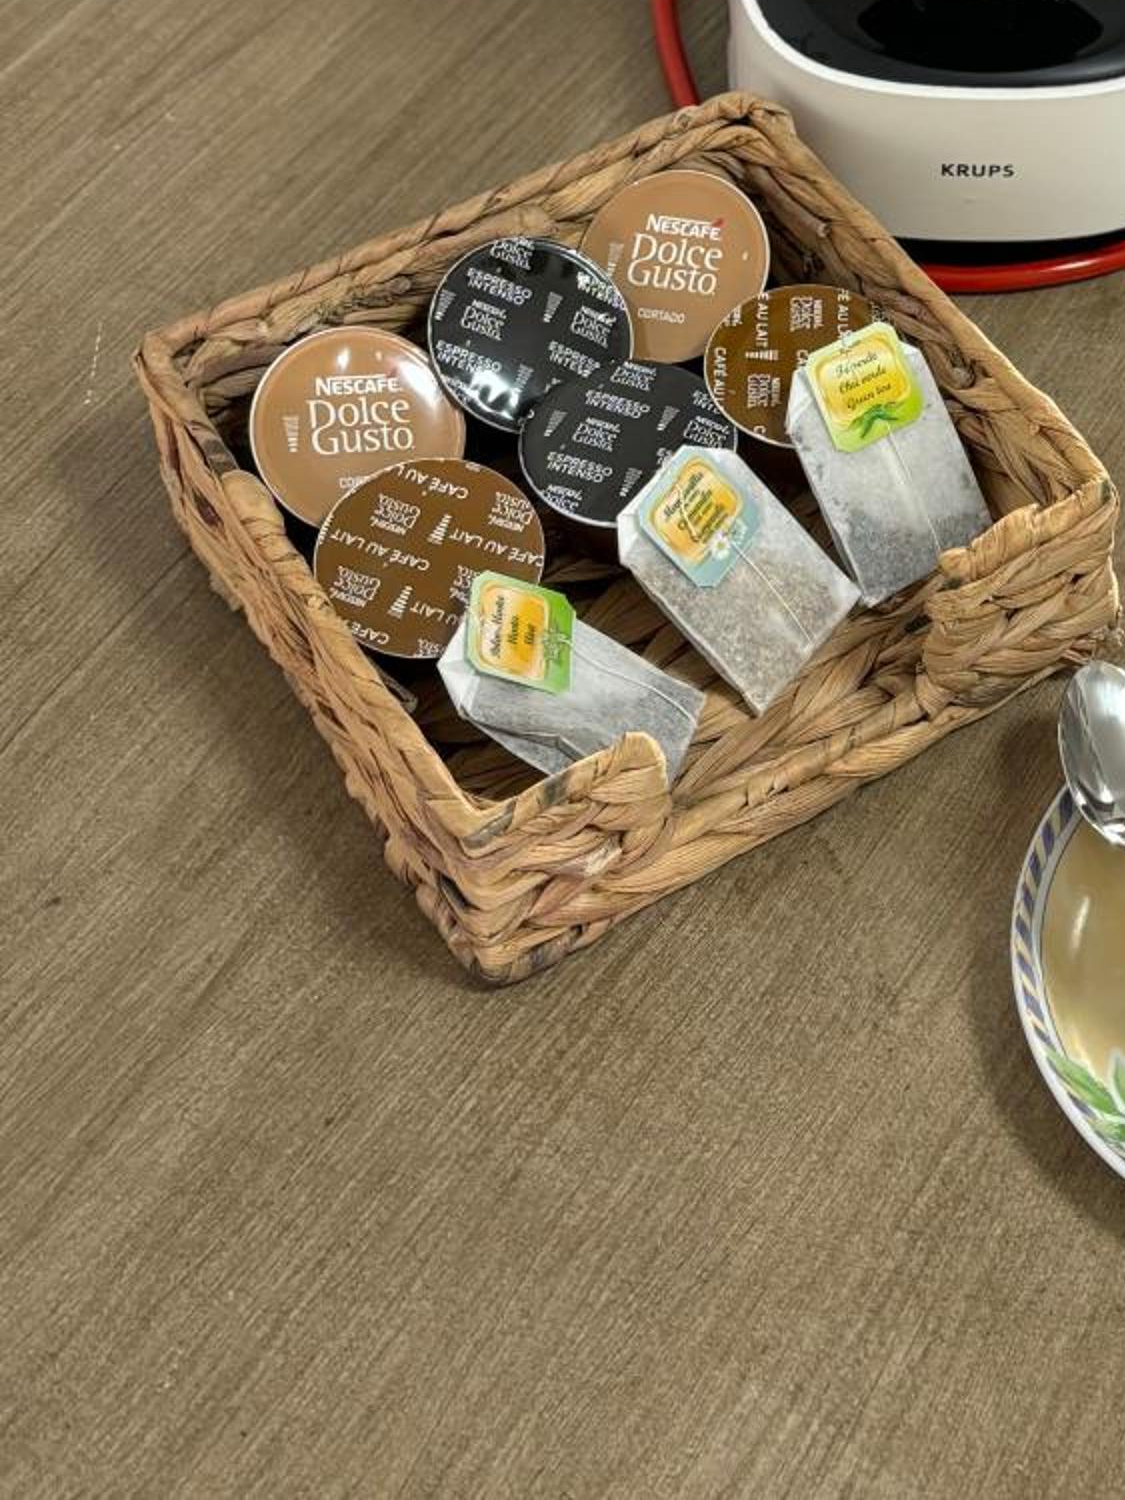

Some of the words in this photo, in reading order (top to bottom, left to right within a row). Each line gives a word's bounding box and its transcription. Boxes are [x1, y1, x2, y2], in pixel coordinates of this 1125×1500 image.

[941, 163, 1015, 177] KRUPS
[630, 231, 723, 271] Dolce
[466, 267, 534, 300] ESPRESSO
[627, 258, 718, 296] Gusto
[466, 275, 526, 306] INTENSO
[637, 307, 686, 324] CORTADO
[757, 302, 769, 321] AU
[837, 306, 850, 322] AU
[755, 323, 769, 348] LAIT
[435, 339, 502, 373] ESPRESSO
[713, 346, 727, 379] CAFÉ
[713, 381, 725, 397] AU
[584, 389, 651, 413] ESPRESSO
[305, 396, 412, 430] Dolce
[311, 422, 414, 456] Gusto
[546, 451, 614, 478] ESPRESSO
[546, 459, 604, 484] INTENSO
[404, 468, 426, 485] AU
[428, 476, 469, 500] CAFÉ
[329, 528, 365, 549] LAIT
[449, 527, 484, 549] LAIT
[485, 539, 507, 555] AU
[365, 542, 388, 558] AU
[389, 550, 430, 572] CAFÉ
[508, 546, 544, 568] CAFÉ
[409, 600, 444, 622] LAIT
